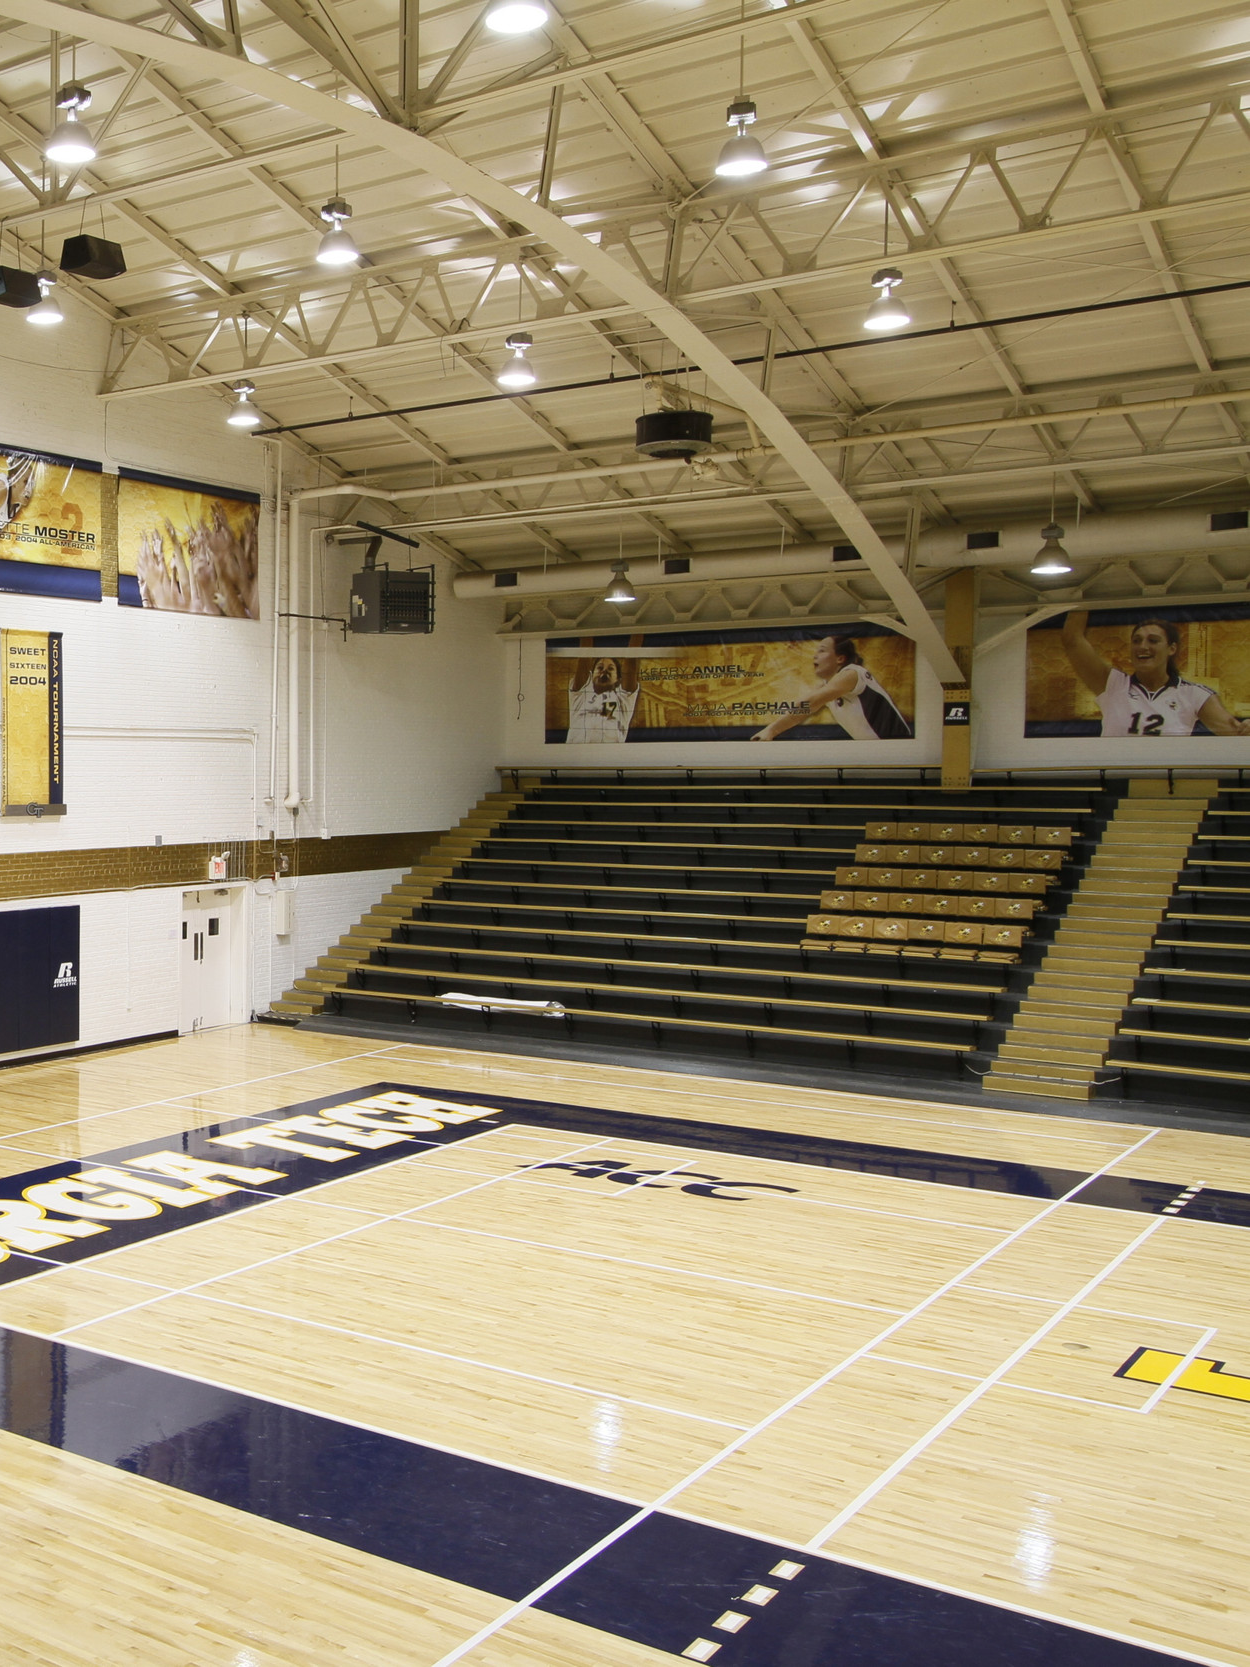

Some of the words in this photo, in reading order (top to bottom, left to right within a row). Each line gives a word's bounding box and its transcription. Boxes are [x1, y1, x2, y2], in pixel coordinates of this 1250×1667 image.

[34, 525, 96, 543] MOSTER
[15, 535, 38, 544] 2004
[39, 538, 96, 551] ALL-AMERICAN
[10, 647, 46, 656] SWEET
[10, 662, 47, 670] SIXTEEN
[640, 666, 688, 676] KERRY
[693, 665, 746, 674] ANNEL
[10, 676, 46, 686] 2004
[600, 701, 617, 720] 17
[687, 703, 727, 712] MAJA
[731, 701, 810, 710] PACHALE
[1128, 711, 1165, 737] 12
[26, 802, 44, 818] GT
[204, 1090, 504, 1163] TECH
